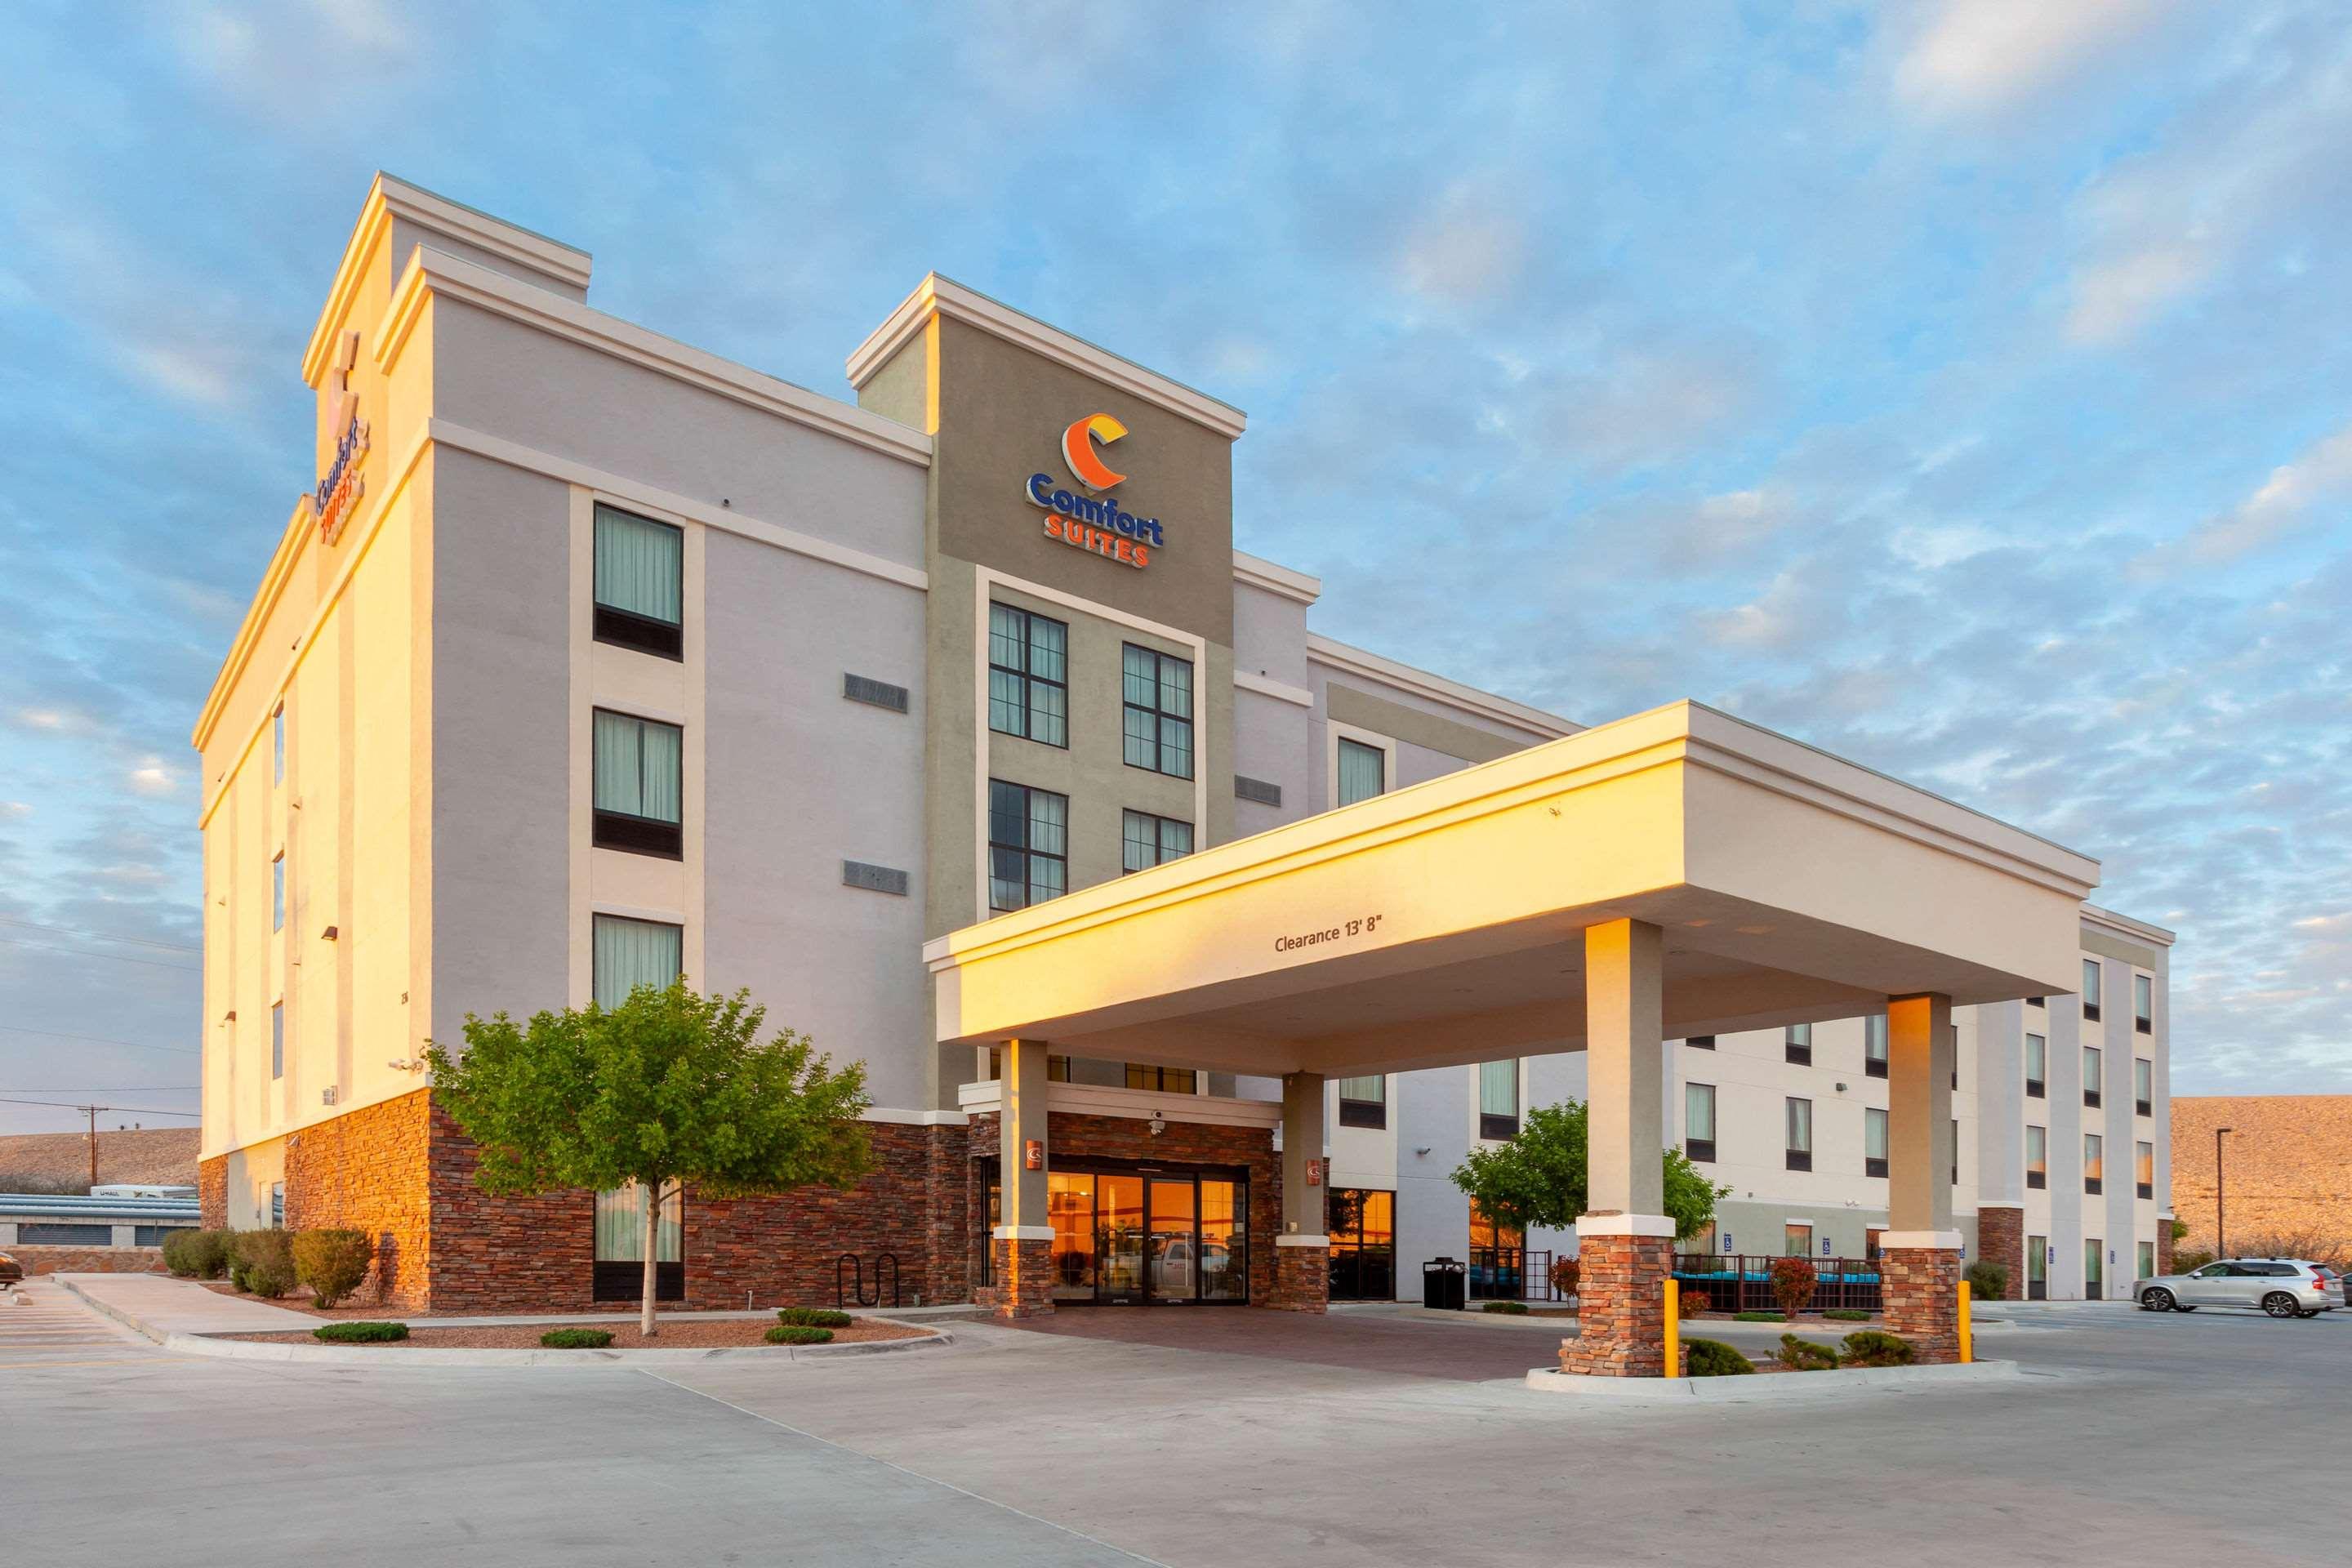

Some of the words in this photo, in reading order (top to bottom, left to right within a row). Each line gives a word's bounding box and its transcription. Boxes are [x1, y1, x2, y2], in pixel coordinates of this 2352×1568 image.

[1027, 473, 1163, 548] Comfort
[1045, 514, 1149, 569] SUITES
[1275, 928, 1340, 952] Clearance
[1345, 920, 1362, 936] 13'
[1366, 915, 1383, 932] 8"
